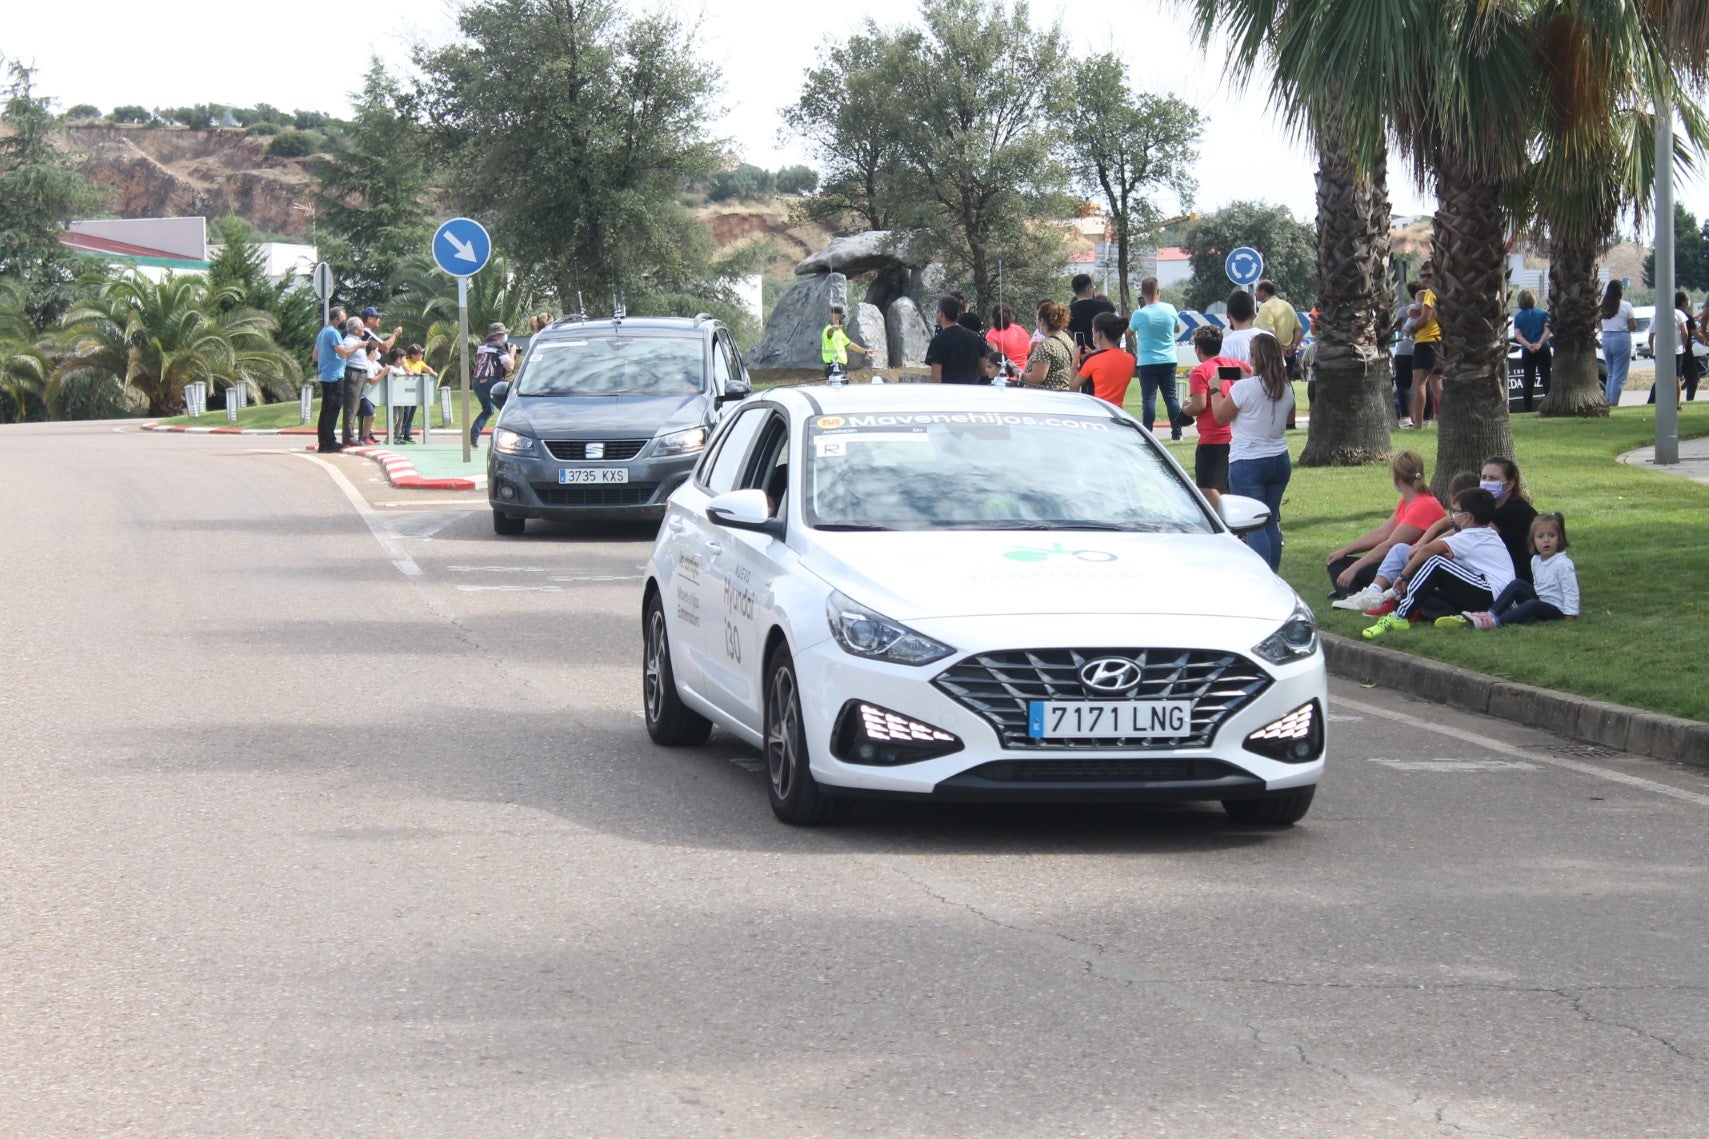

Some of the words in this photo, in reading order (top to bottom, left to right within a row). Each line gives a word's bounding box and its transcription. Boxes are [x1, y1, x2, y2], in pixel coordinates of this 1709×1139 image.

[847, 412, 1109, 432] Mavenehijos.com
[824, 444, 840, 454] R
[568, 470, 596, 482] 3735
[602, 470, 624, 482] KXS
[724, 576, 754, 621] Hyundai
[724, 616, 742, 665] i30
[1051, 707, 1119, 733] 7171
[1132, 706, 1184, 732] LNG
